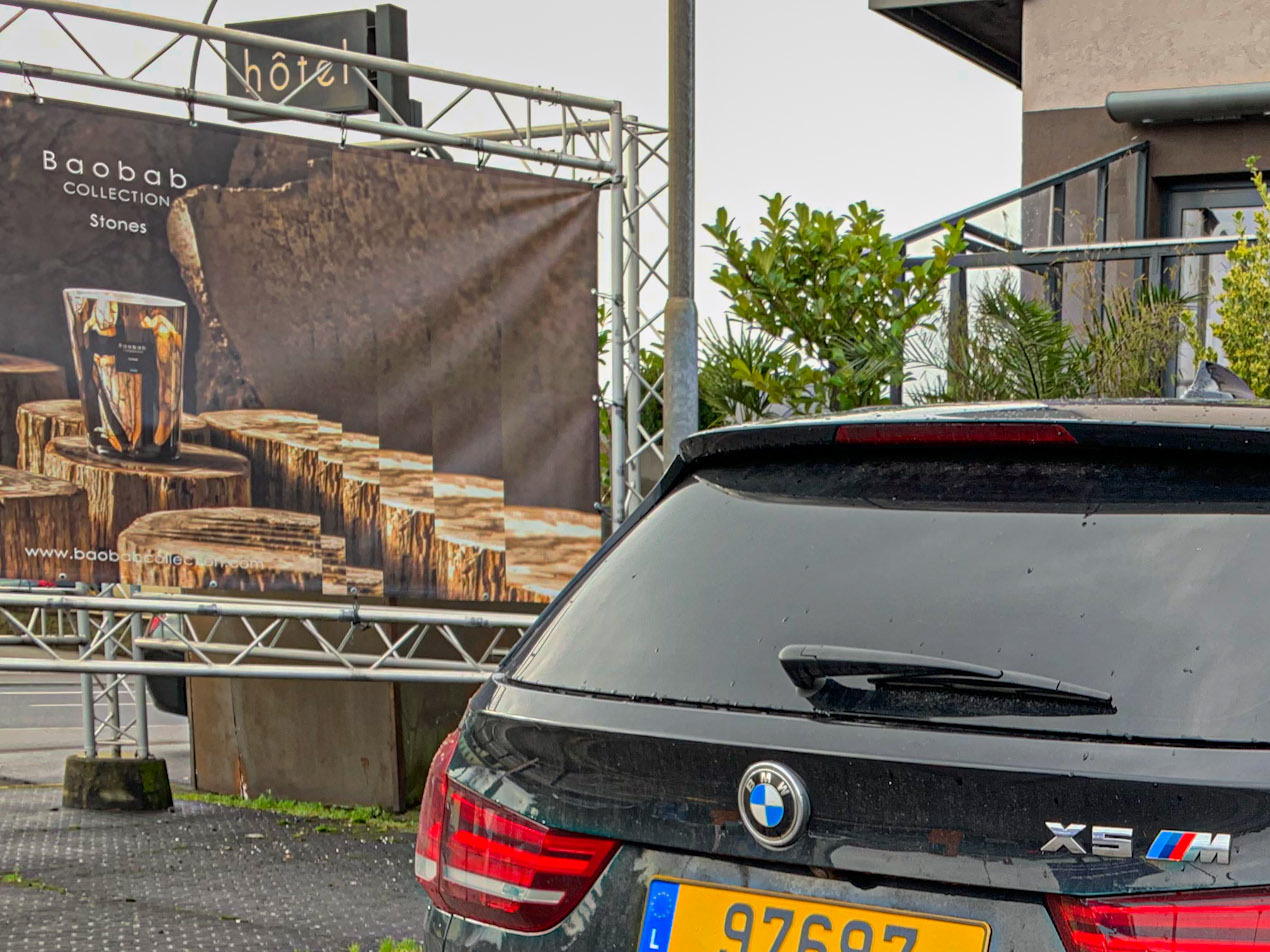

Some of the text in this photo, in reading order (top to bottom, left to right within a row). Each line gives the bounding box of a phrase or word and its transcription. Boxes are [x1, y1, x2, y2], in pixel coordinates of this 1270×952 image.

[243, 38, 347, 93] hôtel
[42, 150, 188, 189] Baobab
[62, 181, 171, 207] COLLECTION
[89, 213, 148, 234] Stones
[745, 771, 790, 797] BMW
[1040, 821, 1232, 865] X5 M
[649, 928, 660, 951] L
